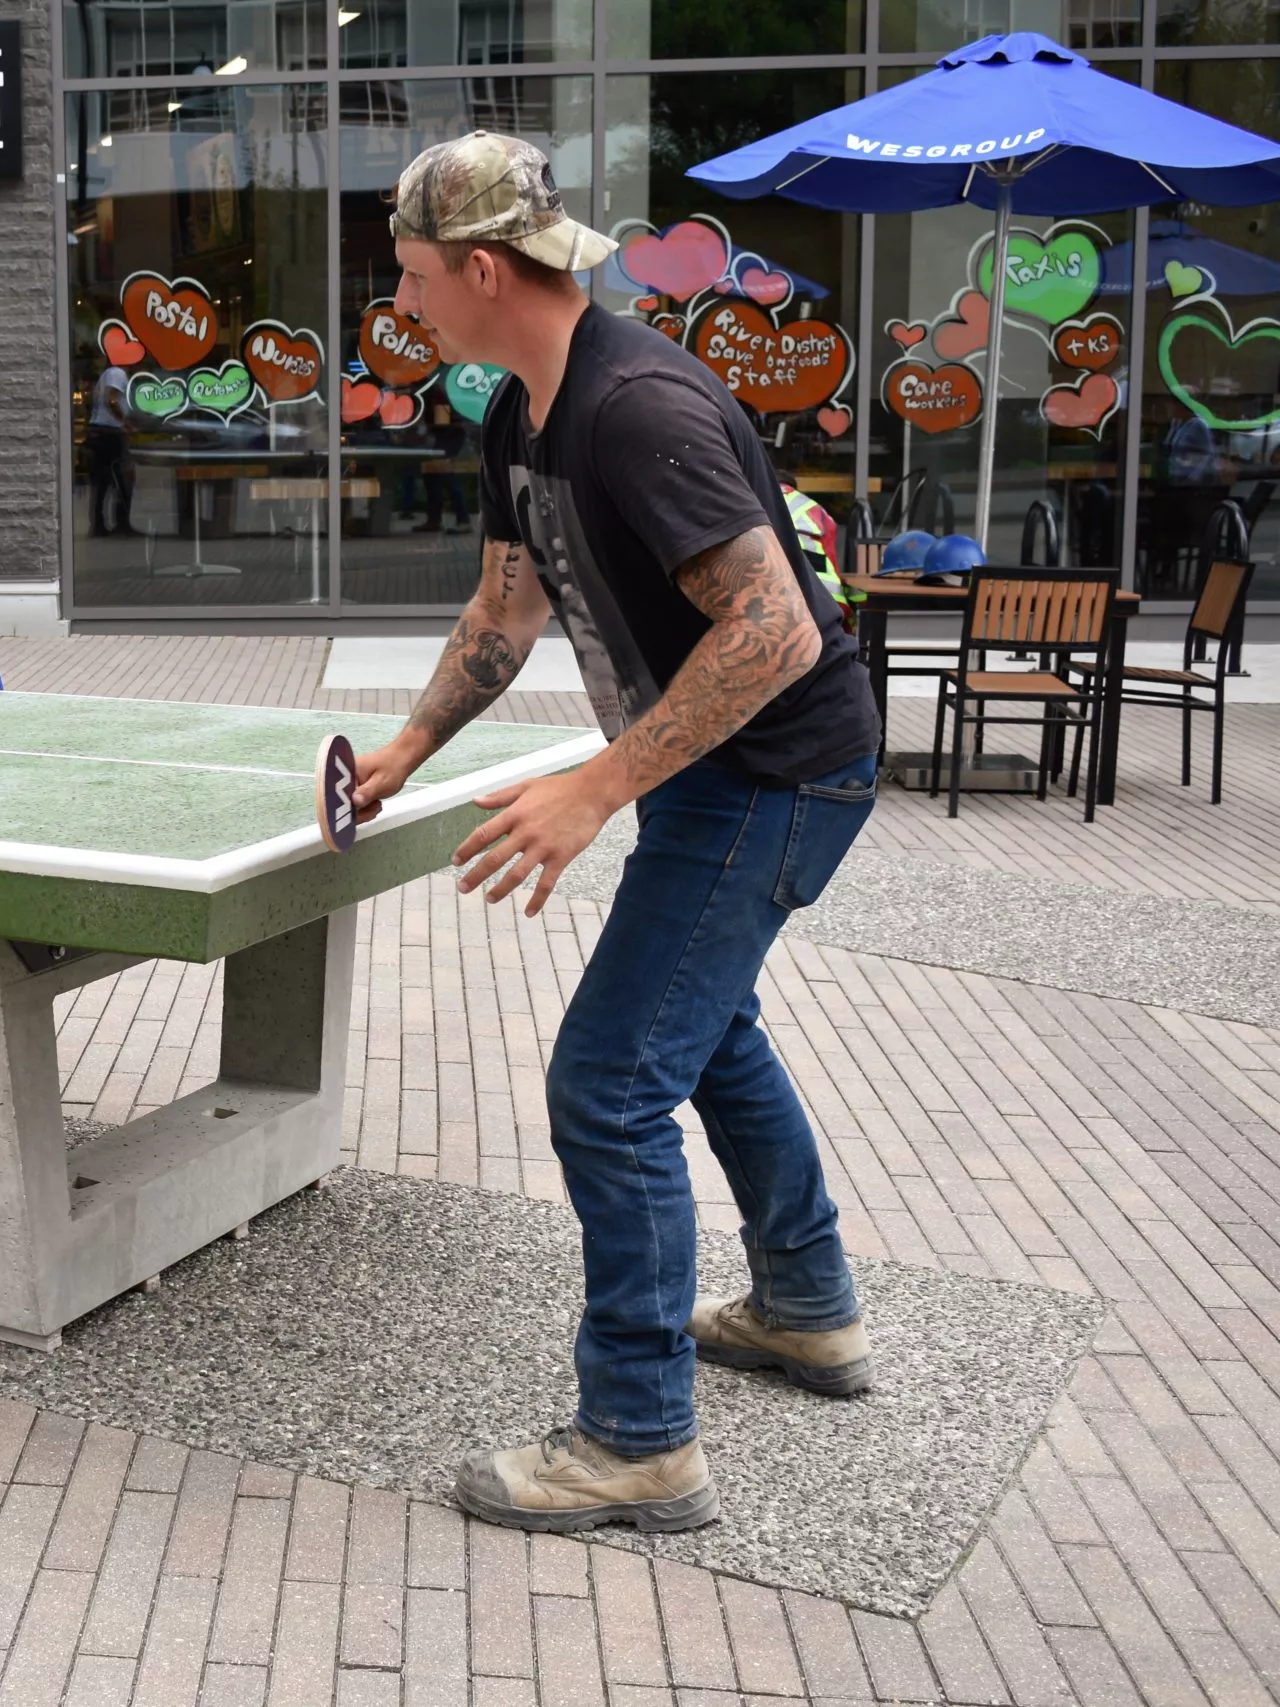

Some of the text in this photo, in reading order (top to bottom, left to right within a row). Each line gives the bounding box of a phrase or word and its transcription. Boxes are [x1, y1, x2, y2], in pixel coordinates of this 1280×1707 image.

[847, 128, 1045, 157] WESGROUP
[146, 289, 208, 342] Postal
[713, 308, 776, 354] River
[372, 314, 433, 363] Police
[707, 334, 754, 365] Save
[727, 365, 798, 391] Staff
[899, 374, 953, 397] Care
